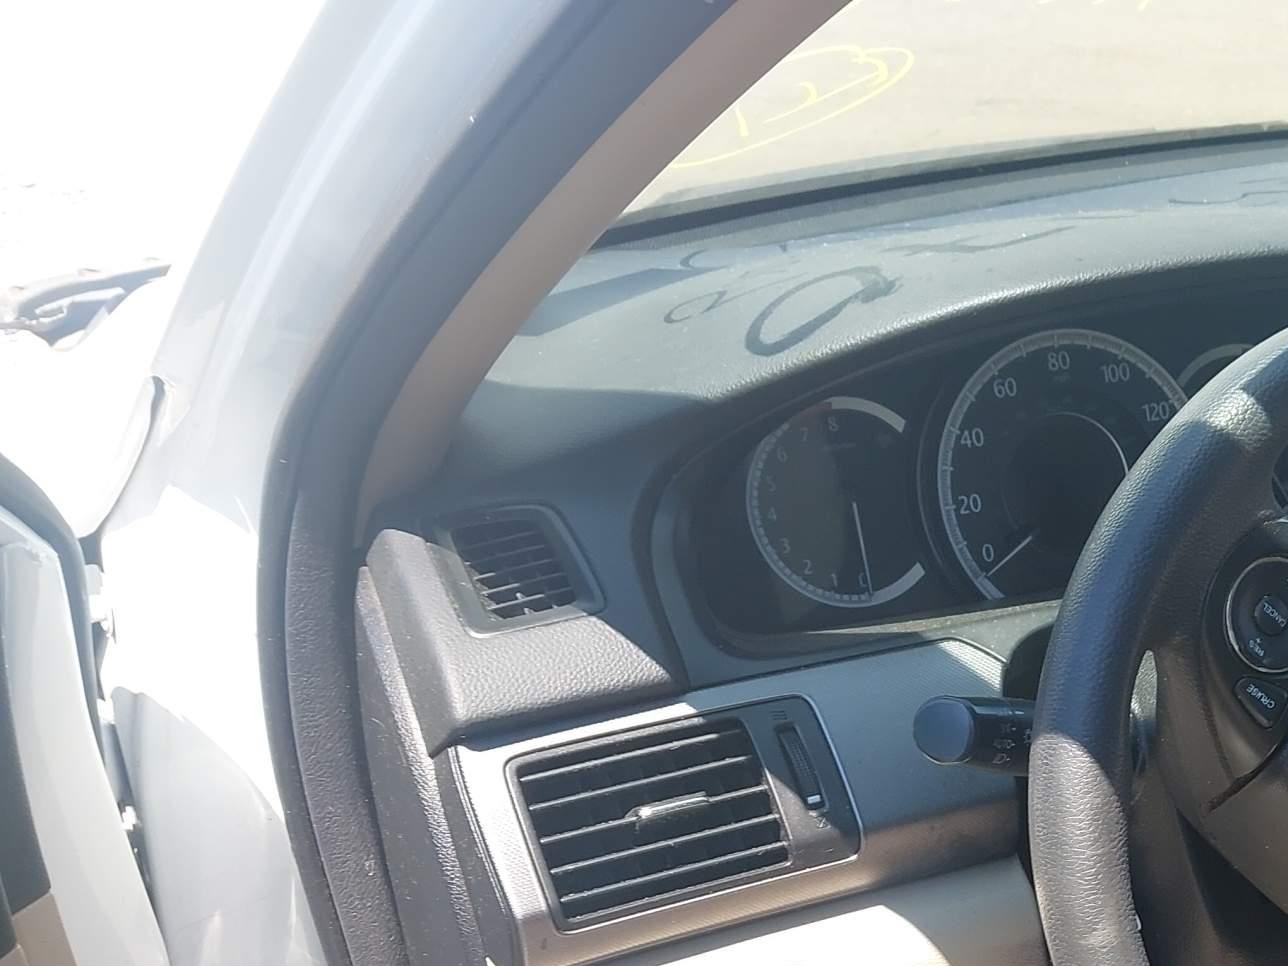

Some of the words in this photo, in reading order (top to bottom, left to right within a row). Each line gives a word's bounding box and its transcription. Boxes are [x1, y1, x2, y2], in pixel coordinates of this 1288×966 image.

[1048, 352, 1070, 370] 80
[1102, 363, 1131, 383] 100
[993, 377, 1017, 399] 60
[1142, 401, 1169, 422] 120
[828, 416, 839, 431] 8
[960, 427, 984, 448] 40
[958, 494, 982, 515] 20
[982, 544, 994, 562] 0
[803, 560, 813, 575] 2
[831, 573, 838, 587] 1
[1263, 602, 1288, 628] CANCEL
[1246, 683, 1276, 709] CRUISE
